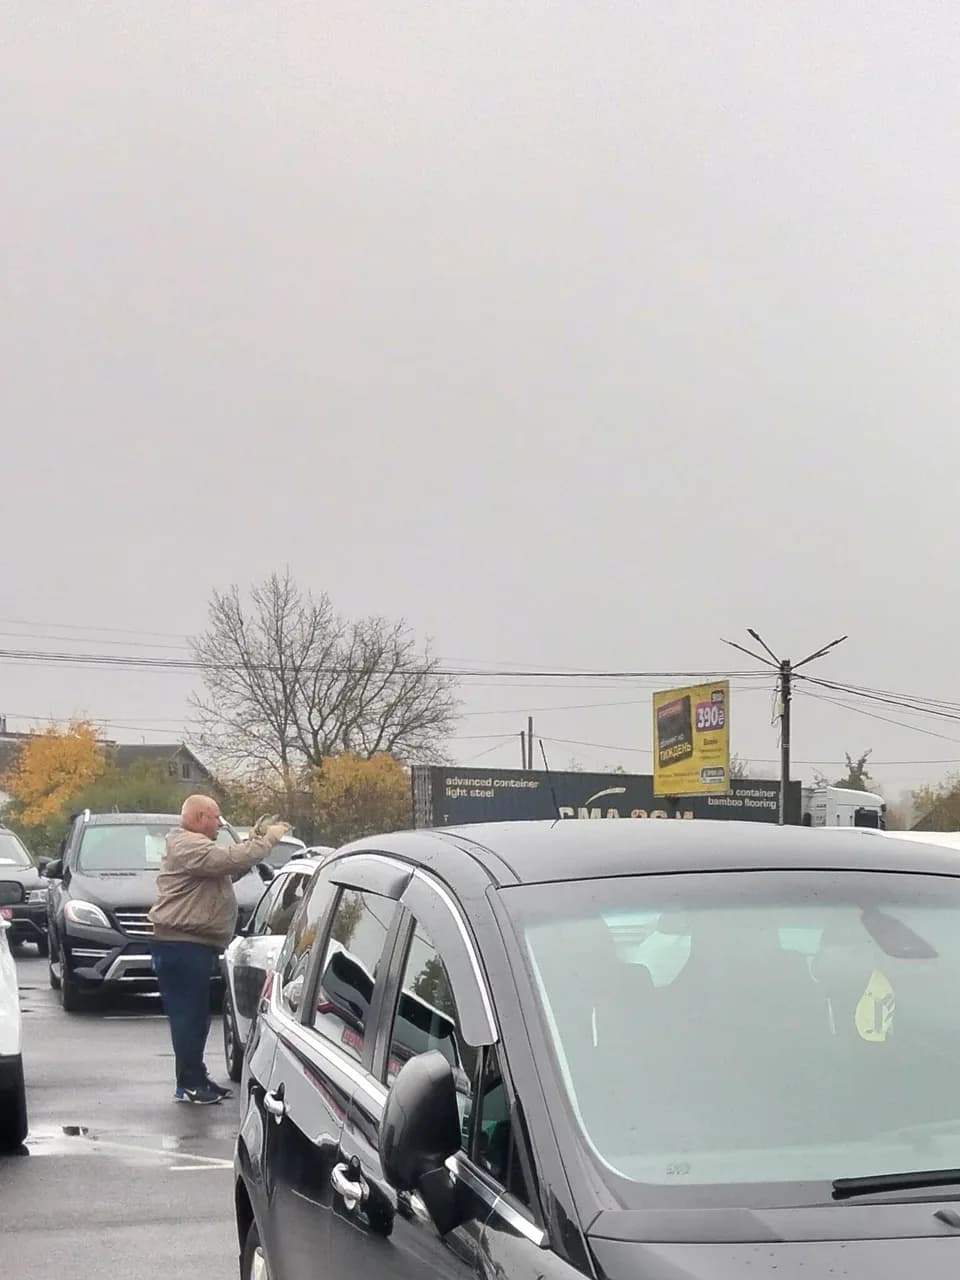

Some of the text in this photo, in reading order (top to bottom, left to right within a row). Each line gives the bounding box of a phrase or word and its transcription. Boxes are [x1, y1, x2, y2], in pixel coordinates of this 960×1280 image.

[446, 776, 539, 789] advanced container
[445, 787, 494, 799] light steel
[735, 788, 777, 798] container
[707, 796, 777, 810] bamboo flooring
